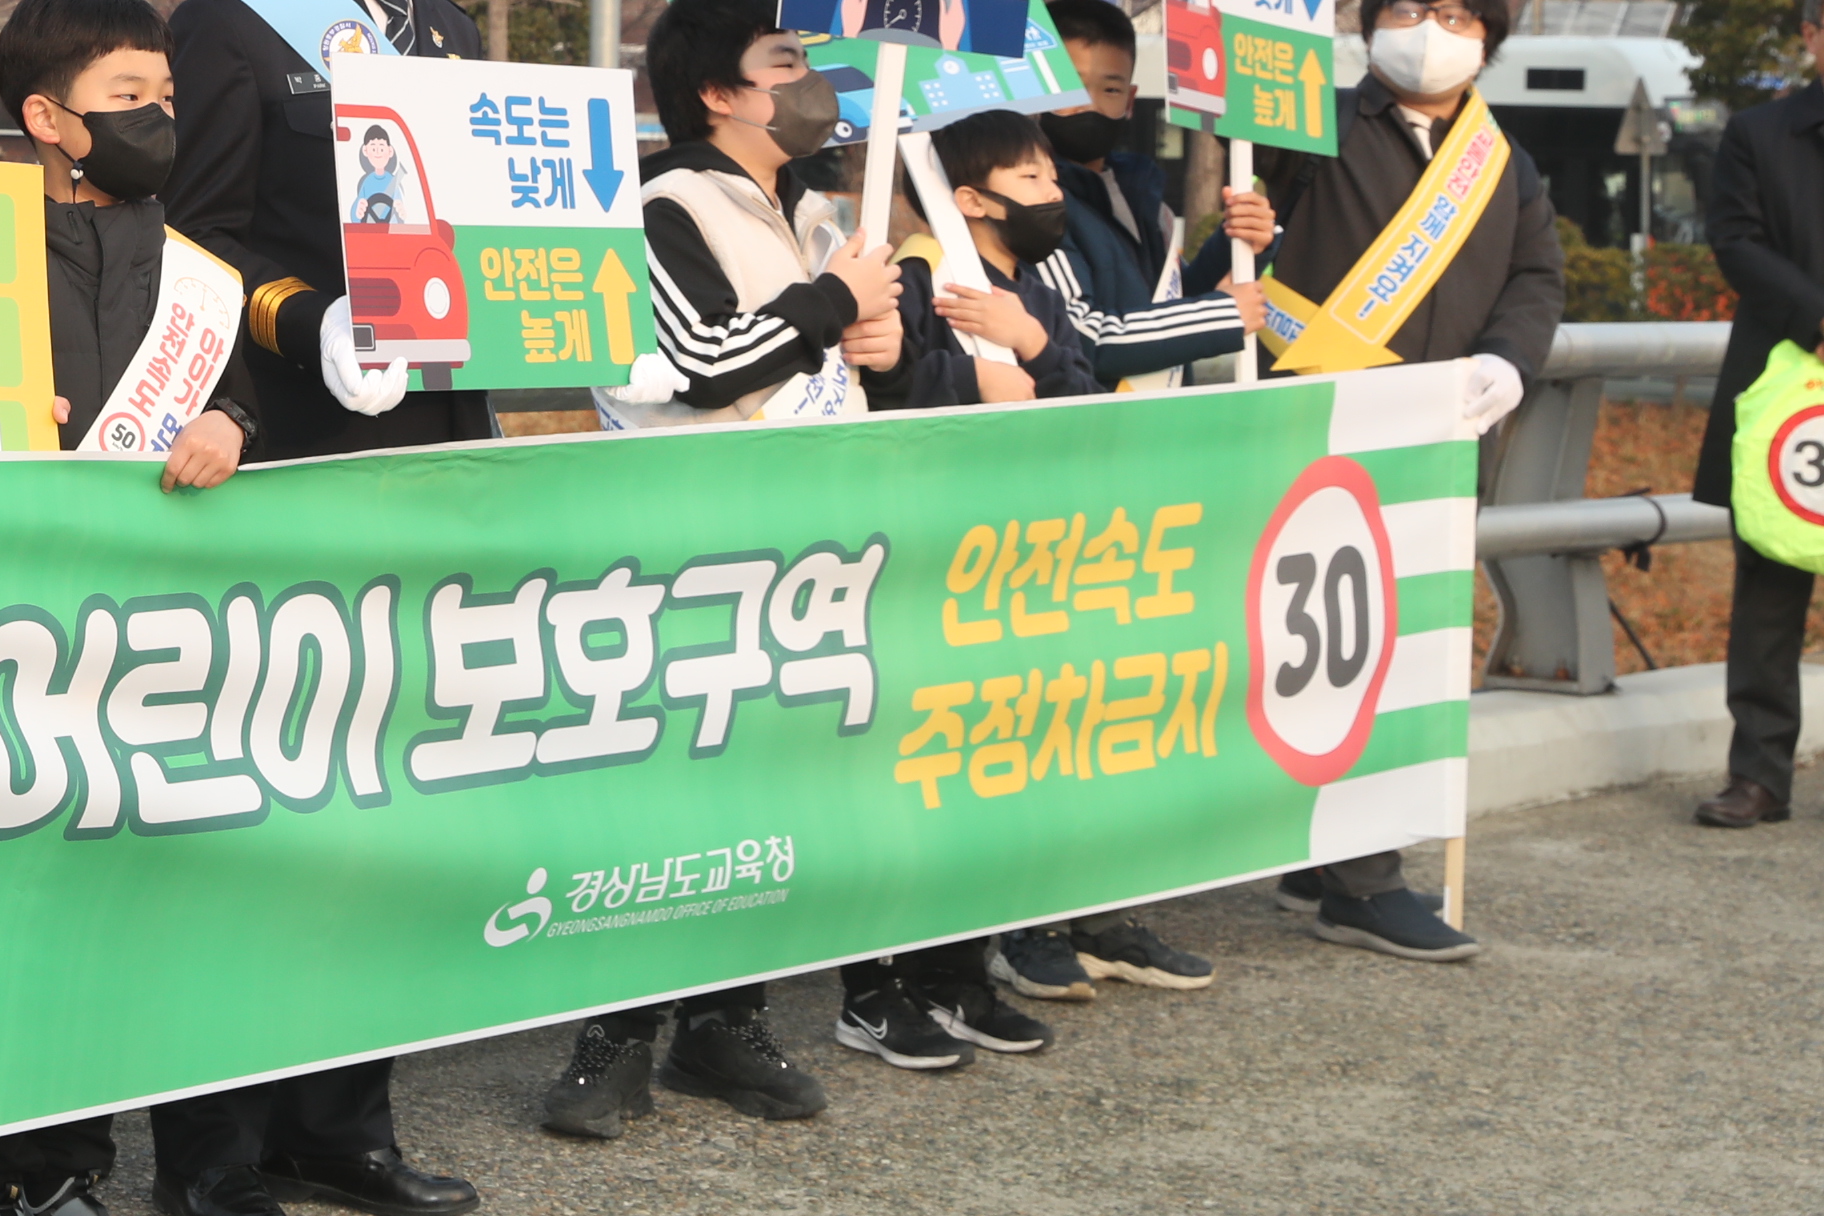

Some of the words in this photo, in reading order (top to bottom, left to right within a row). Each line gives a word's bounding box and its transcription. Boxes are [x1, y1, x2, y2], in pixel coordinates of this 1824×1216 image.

[1233, 32, 1296, 84] 안전은
[469, 92, 571, 148] 속도는
[1253, 83, 1297, 132] 높게
[508, 156, 576, 210] 낮게
[479, 246, 585, 301] 안전은
[128, 302, 196, 418] 안전속도
[520, 308, 593, 364] 높게
[173, 327, 225, 416] 아이가
[111, 423, 137, 450] 50
[941, 502, 1204, 648] 안전속도
[1274, 544, 1371, 699] 30
[406, 538, 887, 784] 보호구역
[893, 640, 1229, 811] 주정차금지
[565, 834, 796, 914] 경상남도교육청
[546, 905, 671, 938] GYEONGSANGNAMDO
[672, 899, 714, 920] OFFICE
[711, 897, 729, 914] OF
[727, 887, 791, 912] EDUCATION
